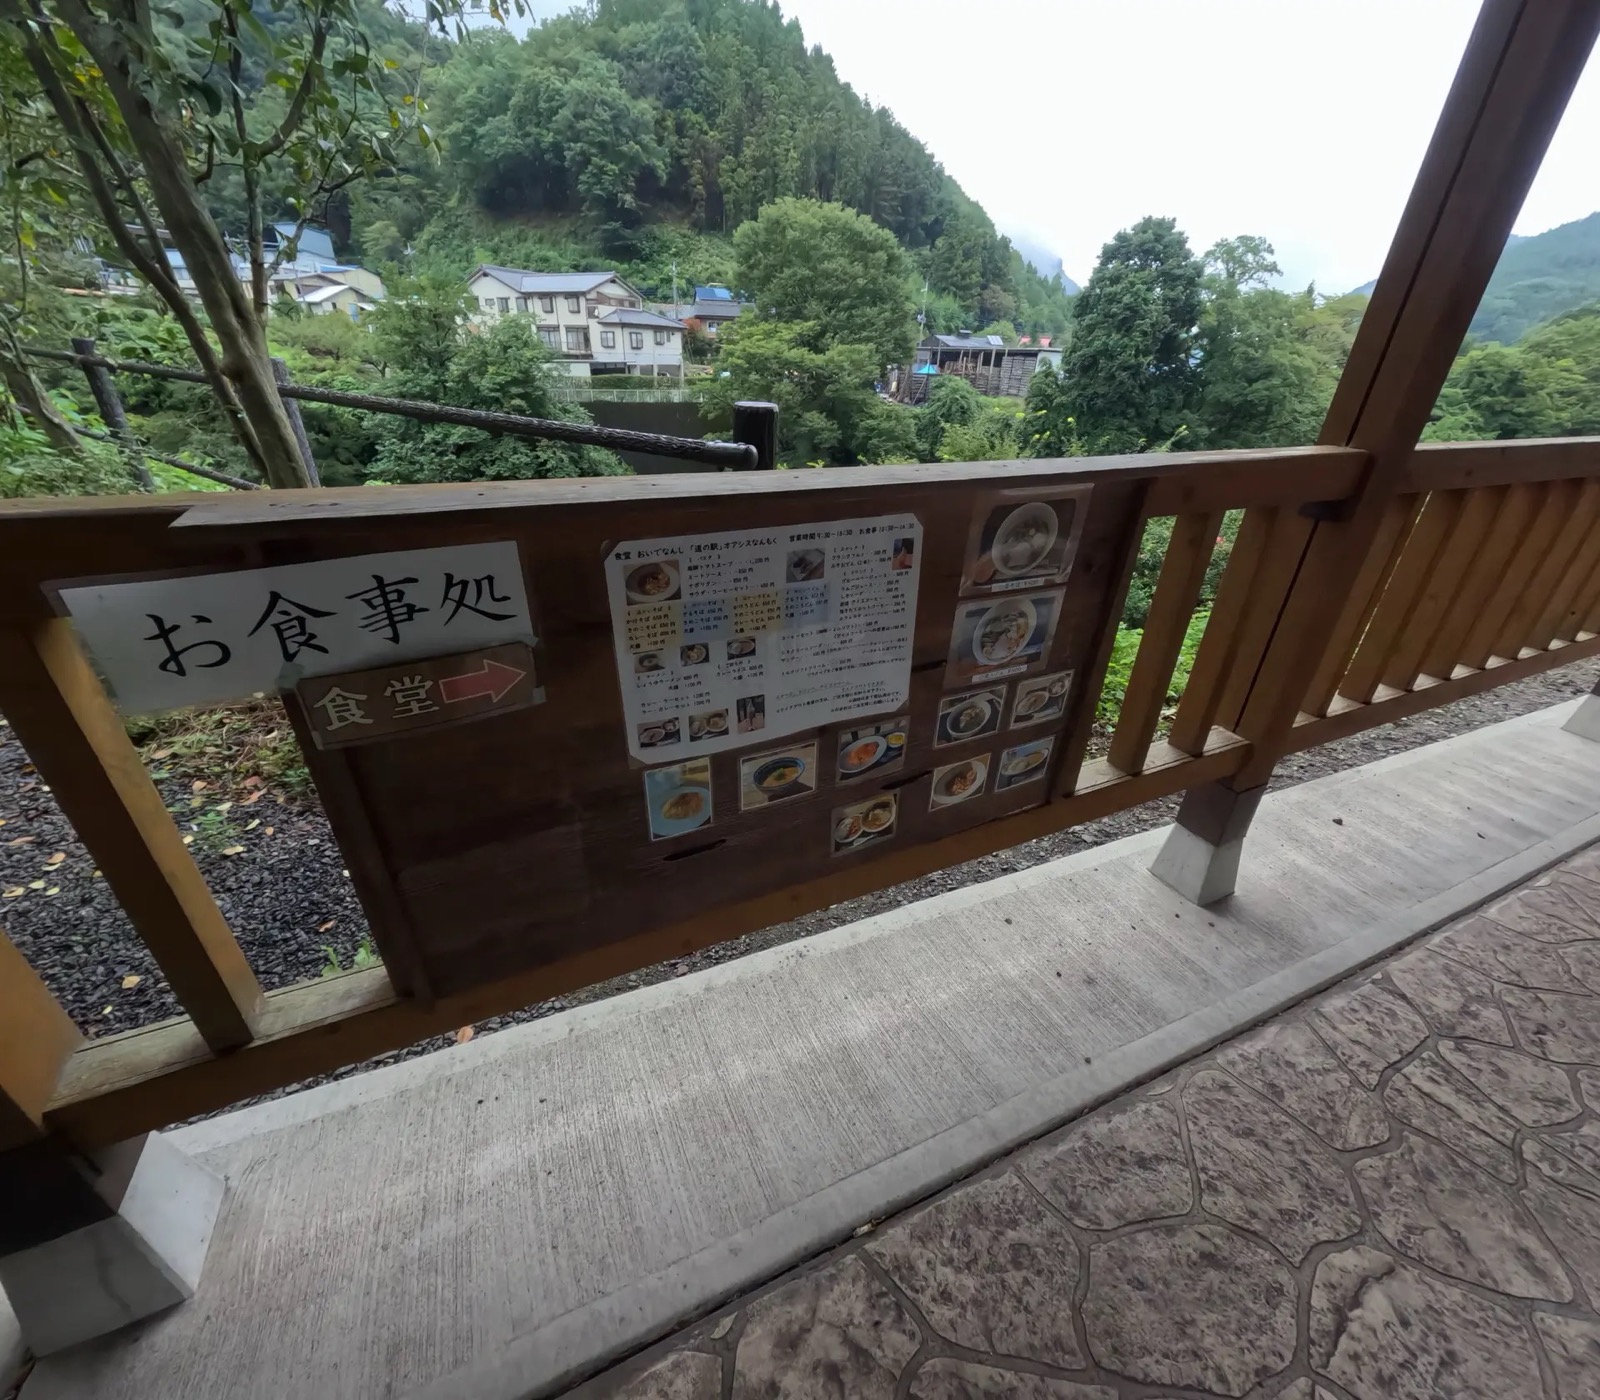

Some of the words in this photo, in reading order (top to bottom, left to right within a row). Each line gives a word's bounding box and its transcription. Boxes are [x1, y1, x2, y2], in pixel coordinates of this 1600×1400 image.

[614, 551, 631, 561] 食堂
[637, 546, 684, 558] おいでなんし
[145, 571, 518, 677] お食事処
[312, 674, 441, 733] 食堂
